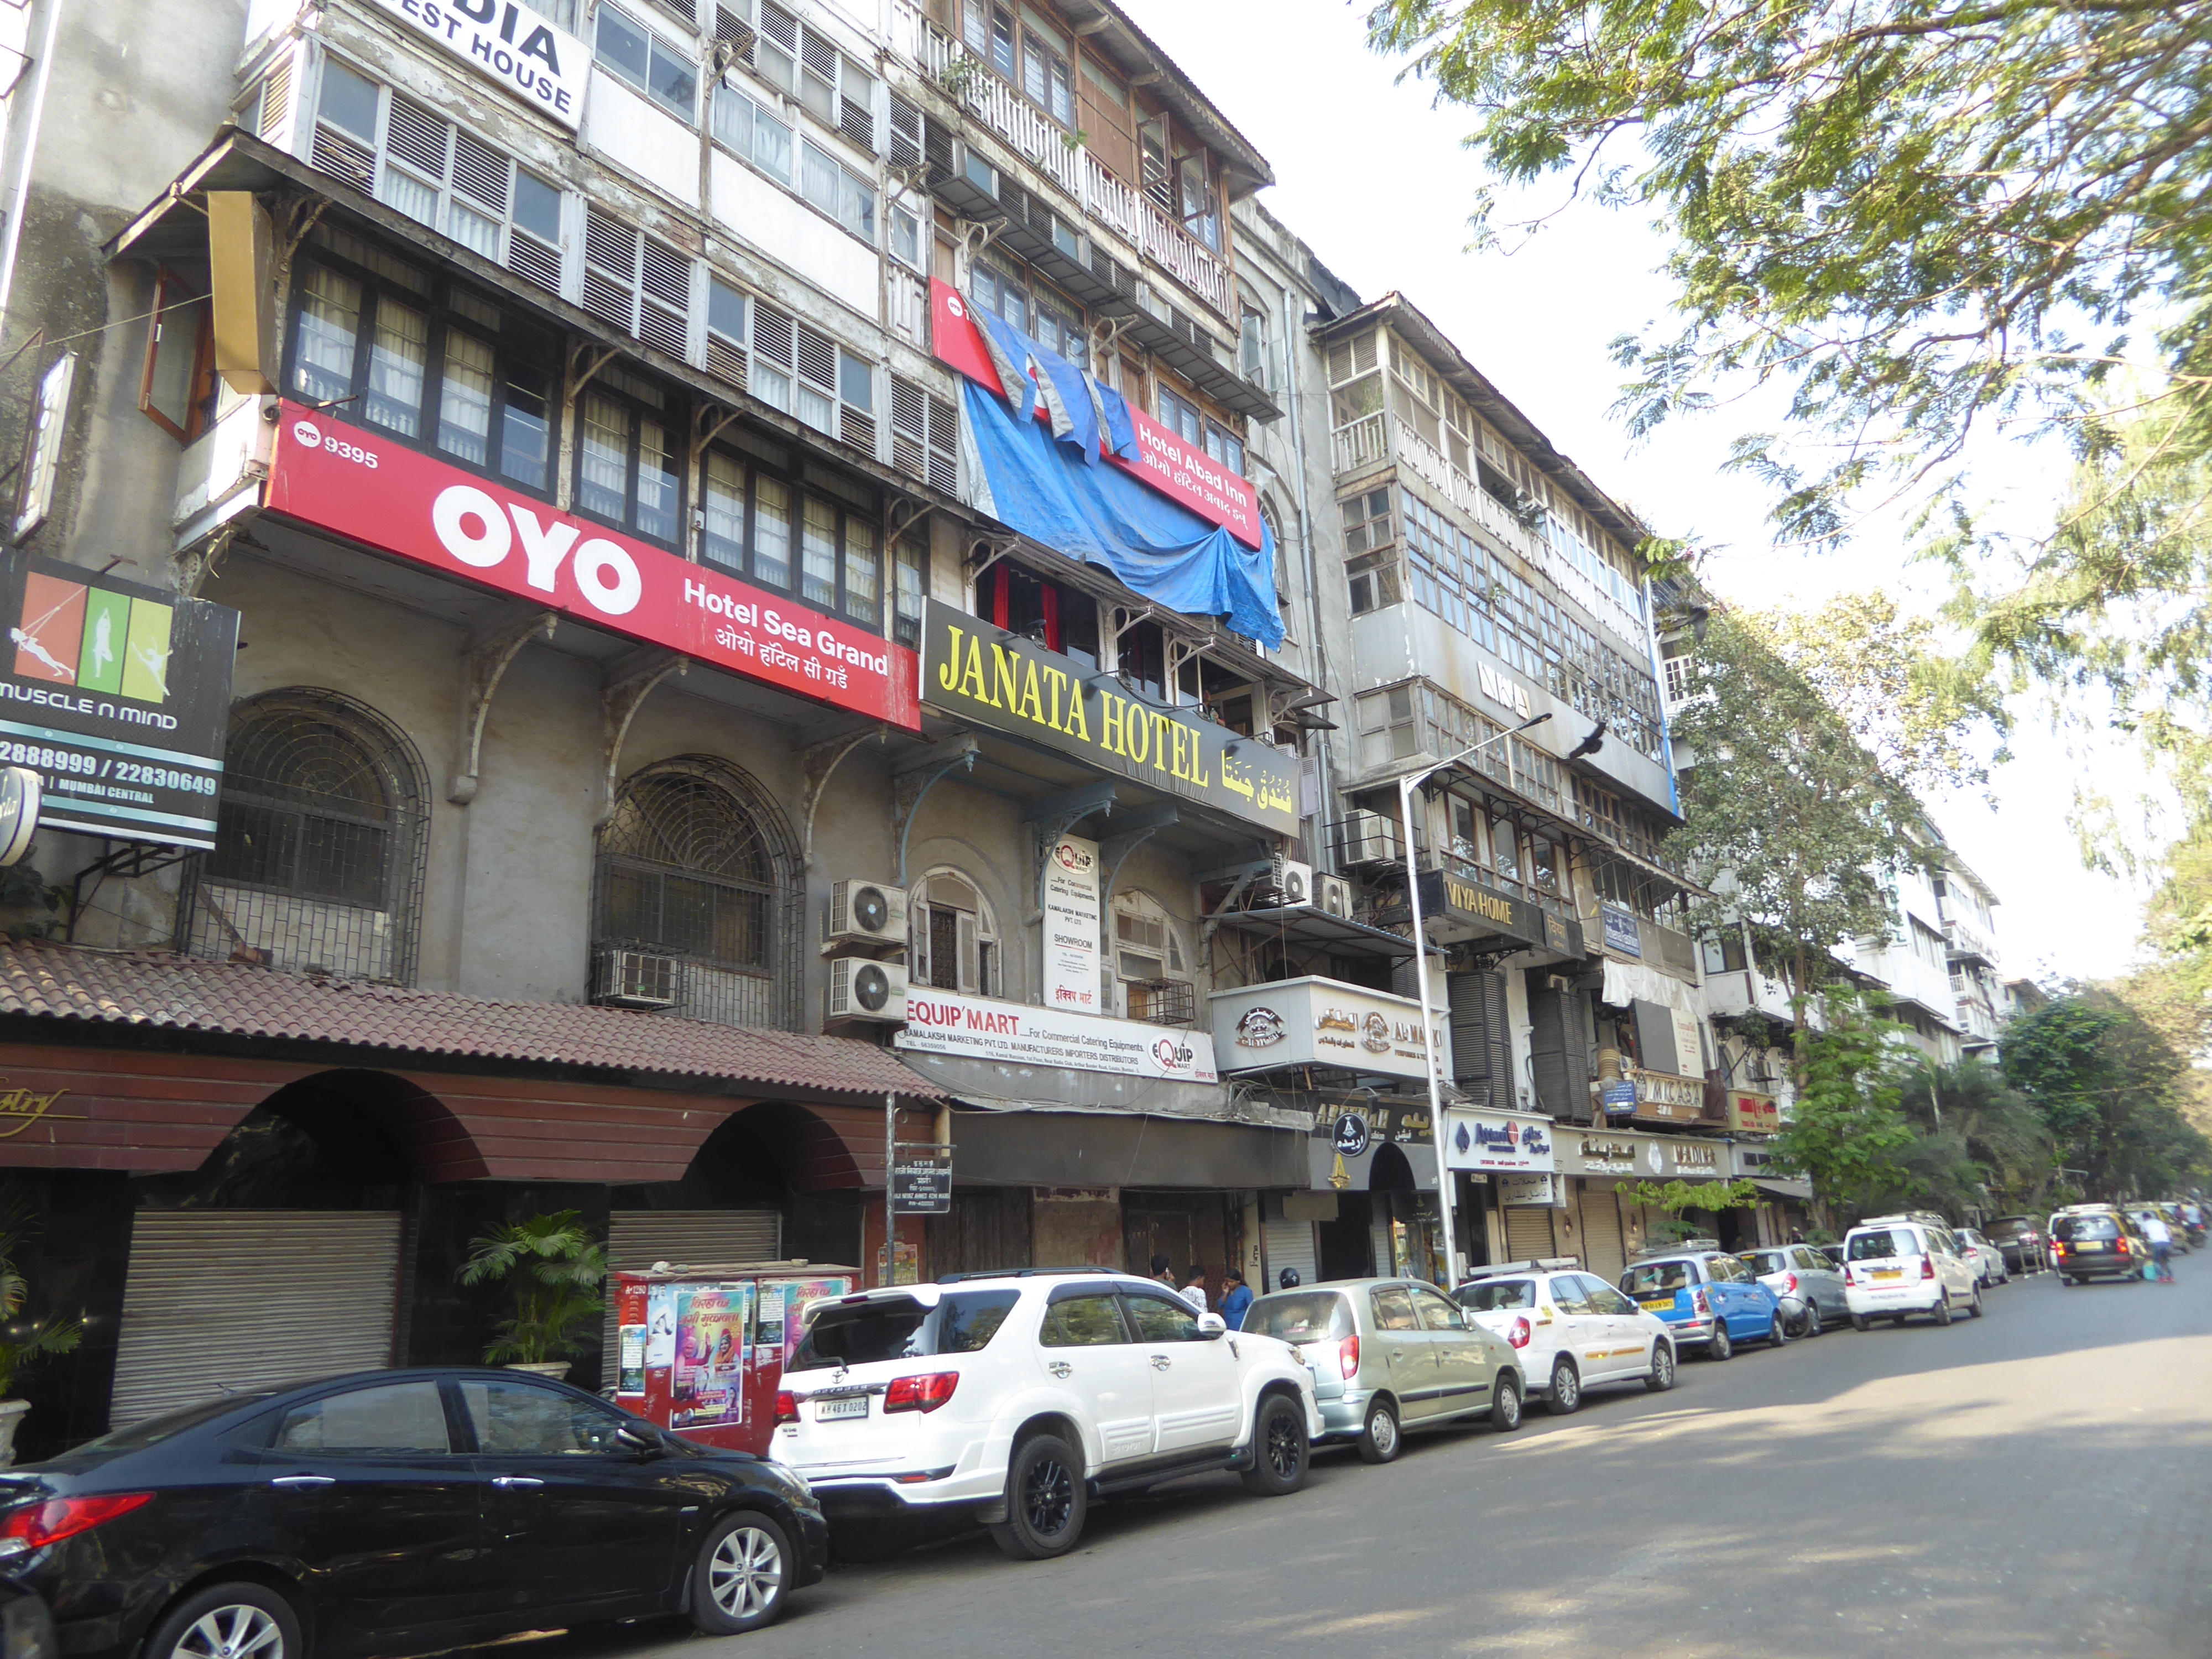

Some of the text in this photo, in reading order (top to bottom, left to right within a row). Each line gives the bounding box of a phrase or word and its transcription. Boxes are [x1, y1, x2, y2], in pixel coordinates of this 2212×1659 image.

[471, 32, 571, 114] HOUSE
[296, 427, 317, 441] OYO
[324, 436, 378, 469] 9395
[1139, 423, 1246, 507] Hotel Abad Inn
[432, 485, 642, 615] OYO
[684, 578, 888, 676] Hotel Sea Grand
[714, 624, 755, 657] ओयो
[802, 655, 822, 681] सी
[939, 624, 1209, 787] JANATA HOTEL
[59, 779, 106, 796] MUMBAI
[107, 787, 155, 804] CENTRAL
[115, 761, 216, 796] 22830649
[1050, 884, 1068, 896] Catering
[1067, 879, 1092, 891] Commercial
[1048, 904, 1097, 921] KAMALAKSHI MARKETING
[1446, 881, 1513, 926] VIYA HOME
[1055, 933, 1092, 950] SHOWROOM
[904, 1029, 1139, 1065] KAMALAKSHI MARKETING PVT. LTD. MANUFACTURERS IMPORTERS DISTRIBUTORS
[920, 1041, 946, 1050] 66359056
[1042, 1030, 1080, 1044] Commercial
[1081, 1035, 1108, 1050] Catering
[1109, 1039, 1145, 1052] Equipments.
[1391, 1021, 1443, 1047] AL-MAKI
[833, 1404, 841, 1413] 46
[842, 1403, 847, 1412] X
[849, 1401, 867, 1411] 0202
